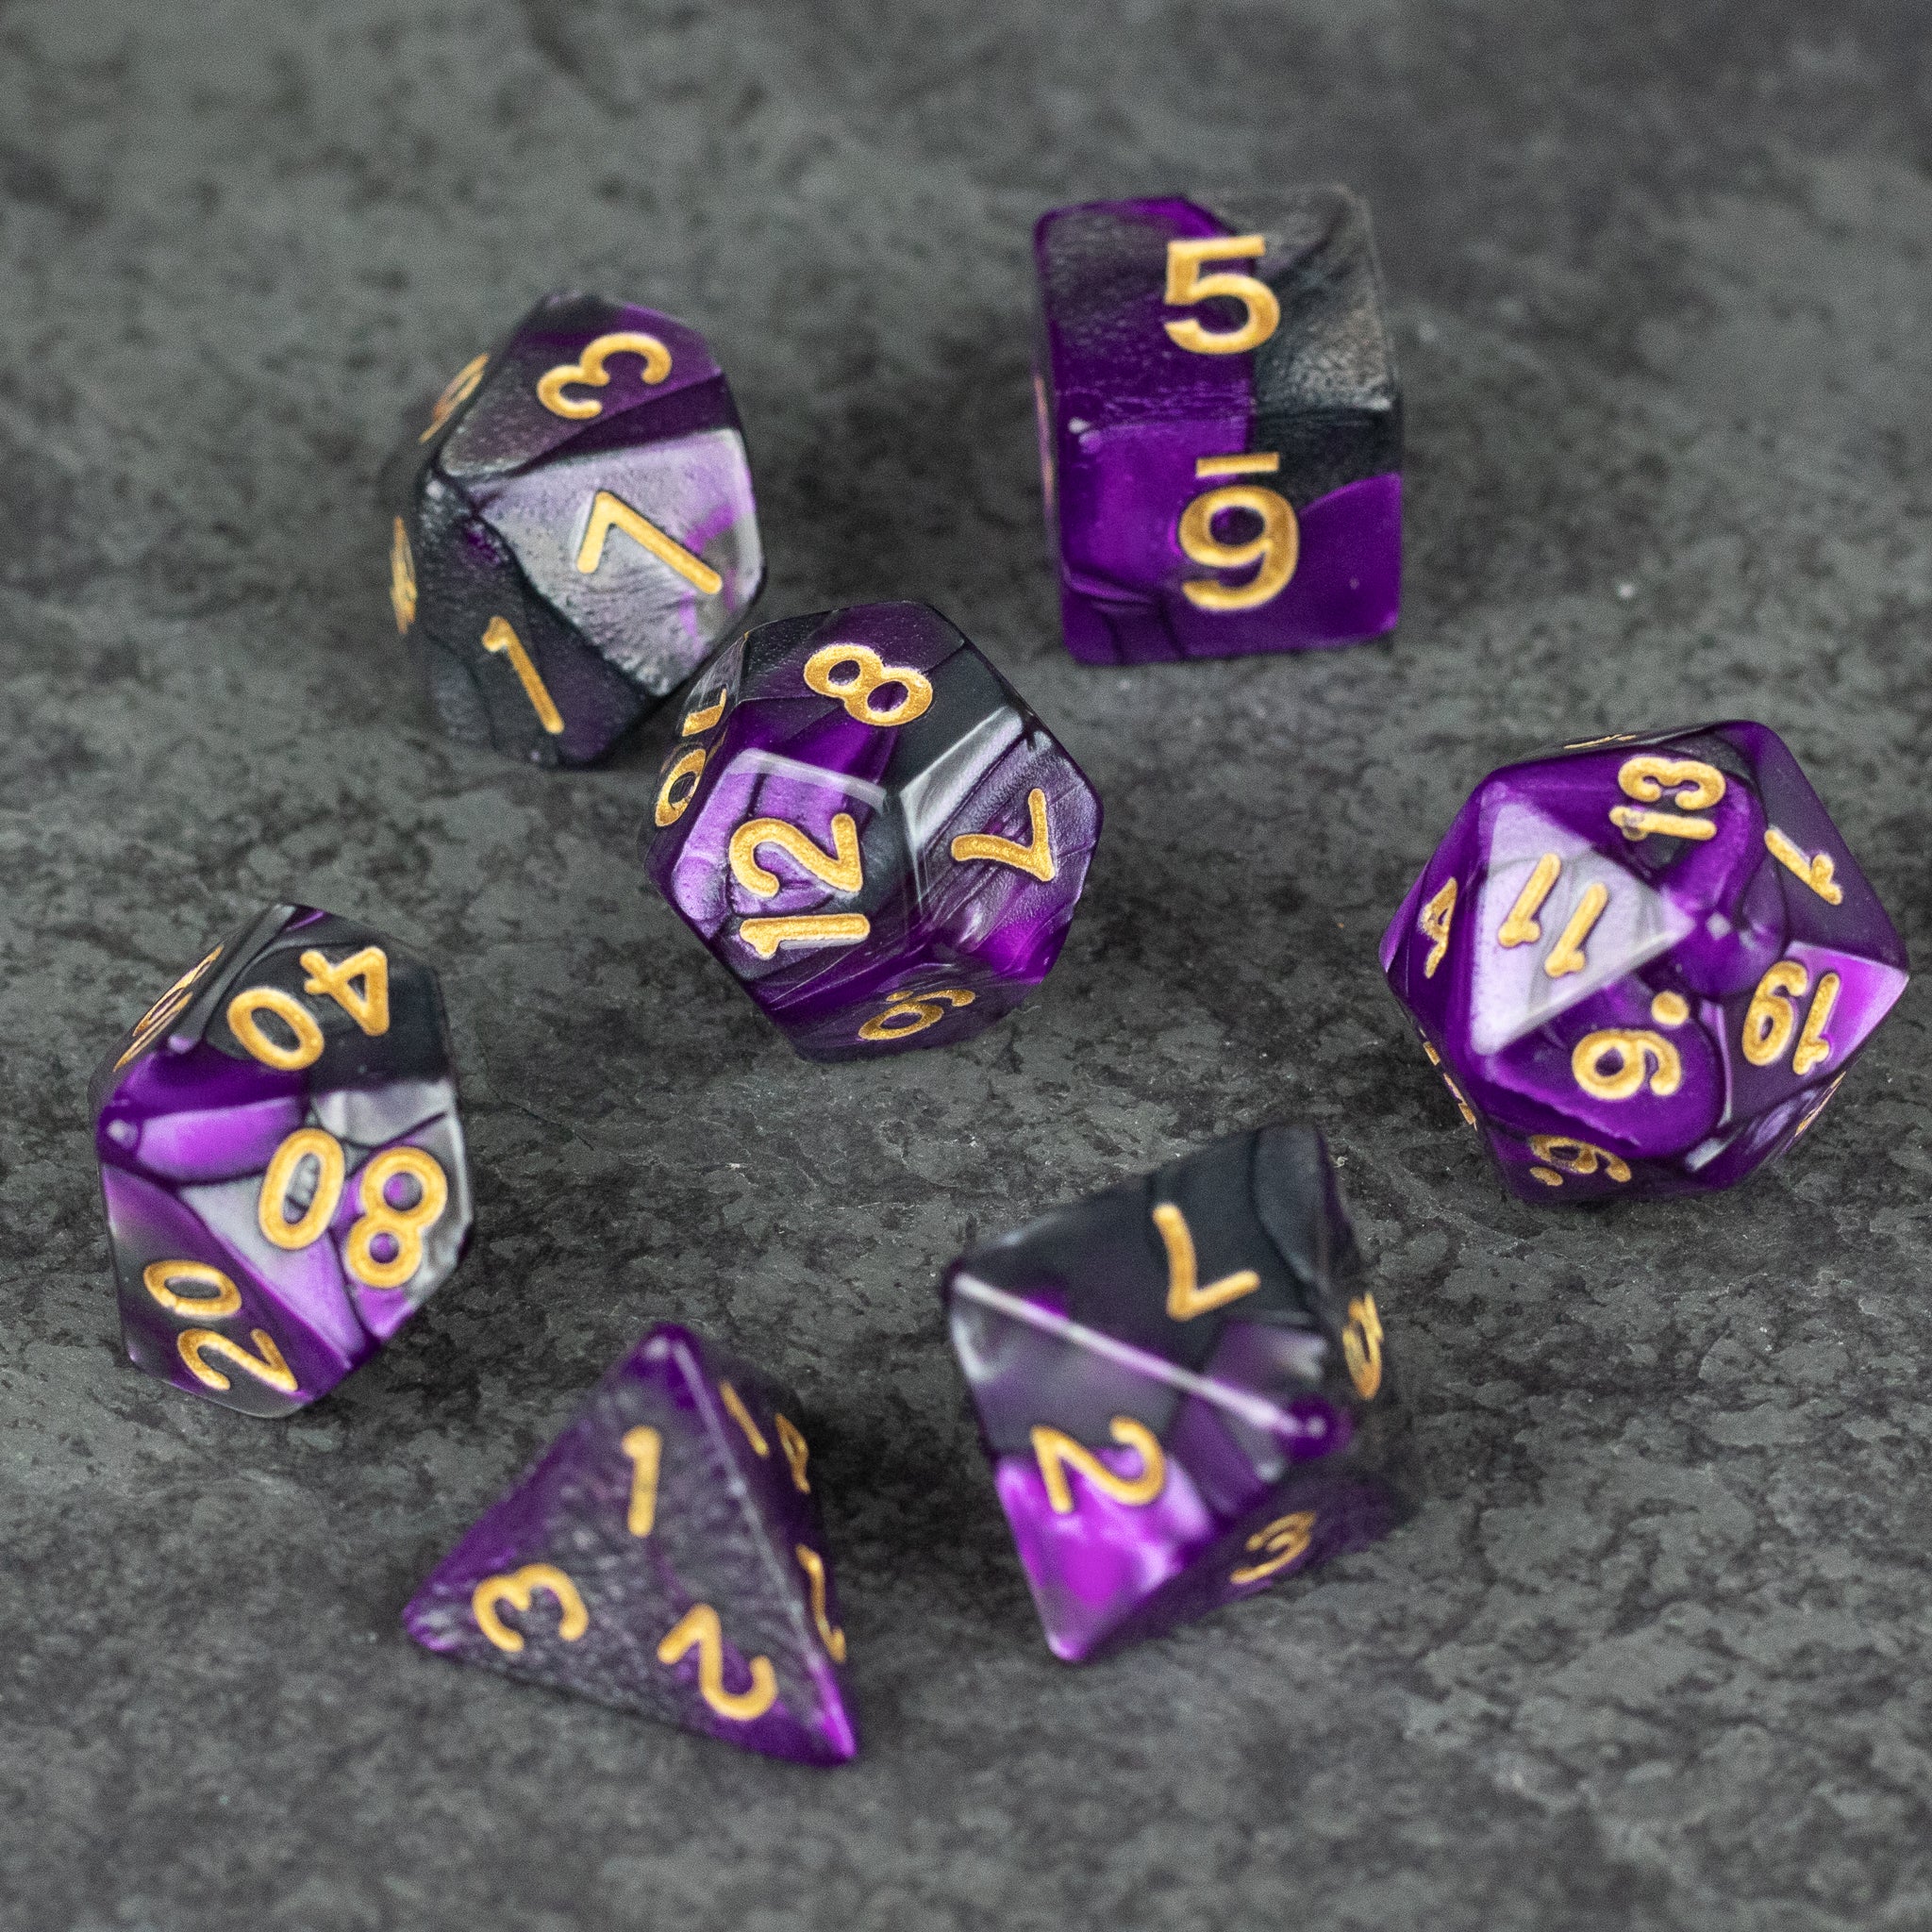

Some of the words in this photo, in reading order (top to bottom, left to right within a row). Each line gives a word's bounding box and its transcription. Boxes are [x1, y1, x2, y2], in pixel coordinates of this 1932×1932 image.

[1164, 235, 1281, 355] 5
[537, 333, 673, 421] 3
[575, 489, 723, 595] 7
[482, 615, 564, 734] 1
[803, 643, 934, 727] 8
[950, 788, 1056, 882] 7
[1608, 757, 1726, 841] 13
[729, 812, 870, 960] 12
[1498, 853, 1607, 977] 11
[1764, 830, 1842, 906] 1
[1417, 877, 1457, 979] 4
[227, 946, 391, 1071] 40
[258, 1128, 448, 1289] 80
[1152, 1204, 1261, 1321] 7
[143, 1259, 298, 1391] 20
[622, 1425, 661, 1538] 1
[1031, 1417, 1166, 1514] 2
[1230, 1511, 1317, 1585] 3
[473, 1563, 589, 1653] 3
[658, 1604, 778, 1721] 2
